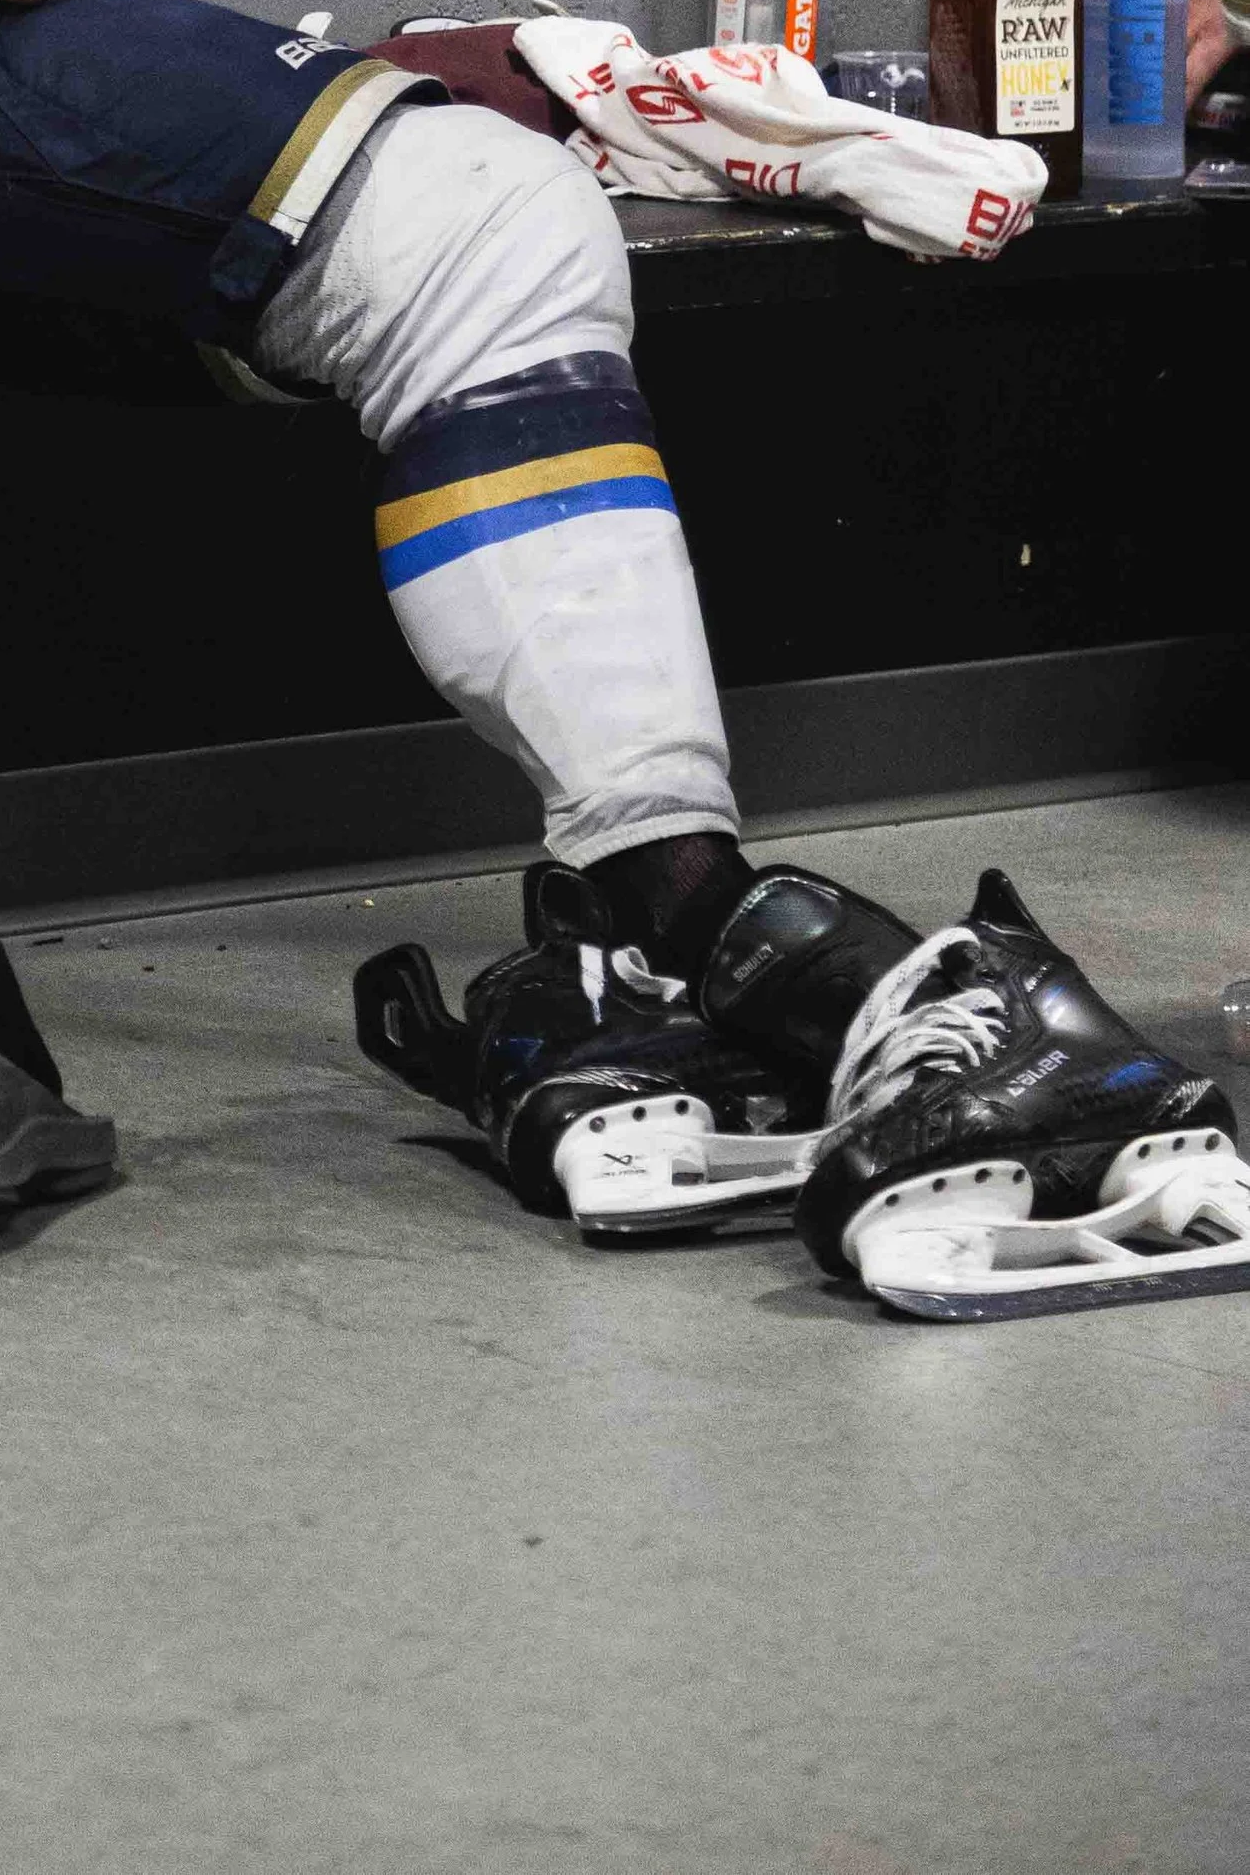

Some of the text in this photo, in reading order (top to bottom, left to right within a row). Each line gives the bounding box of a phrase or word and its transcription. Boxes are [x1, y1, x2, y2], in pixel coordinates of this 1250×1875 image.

[1002, 17, 1067, 44] RAW
[1000, 46, 1069, 61] UNFILTERED
[1002, 61, 1071, 97] HONEY
